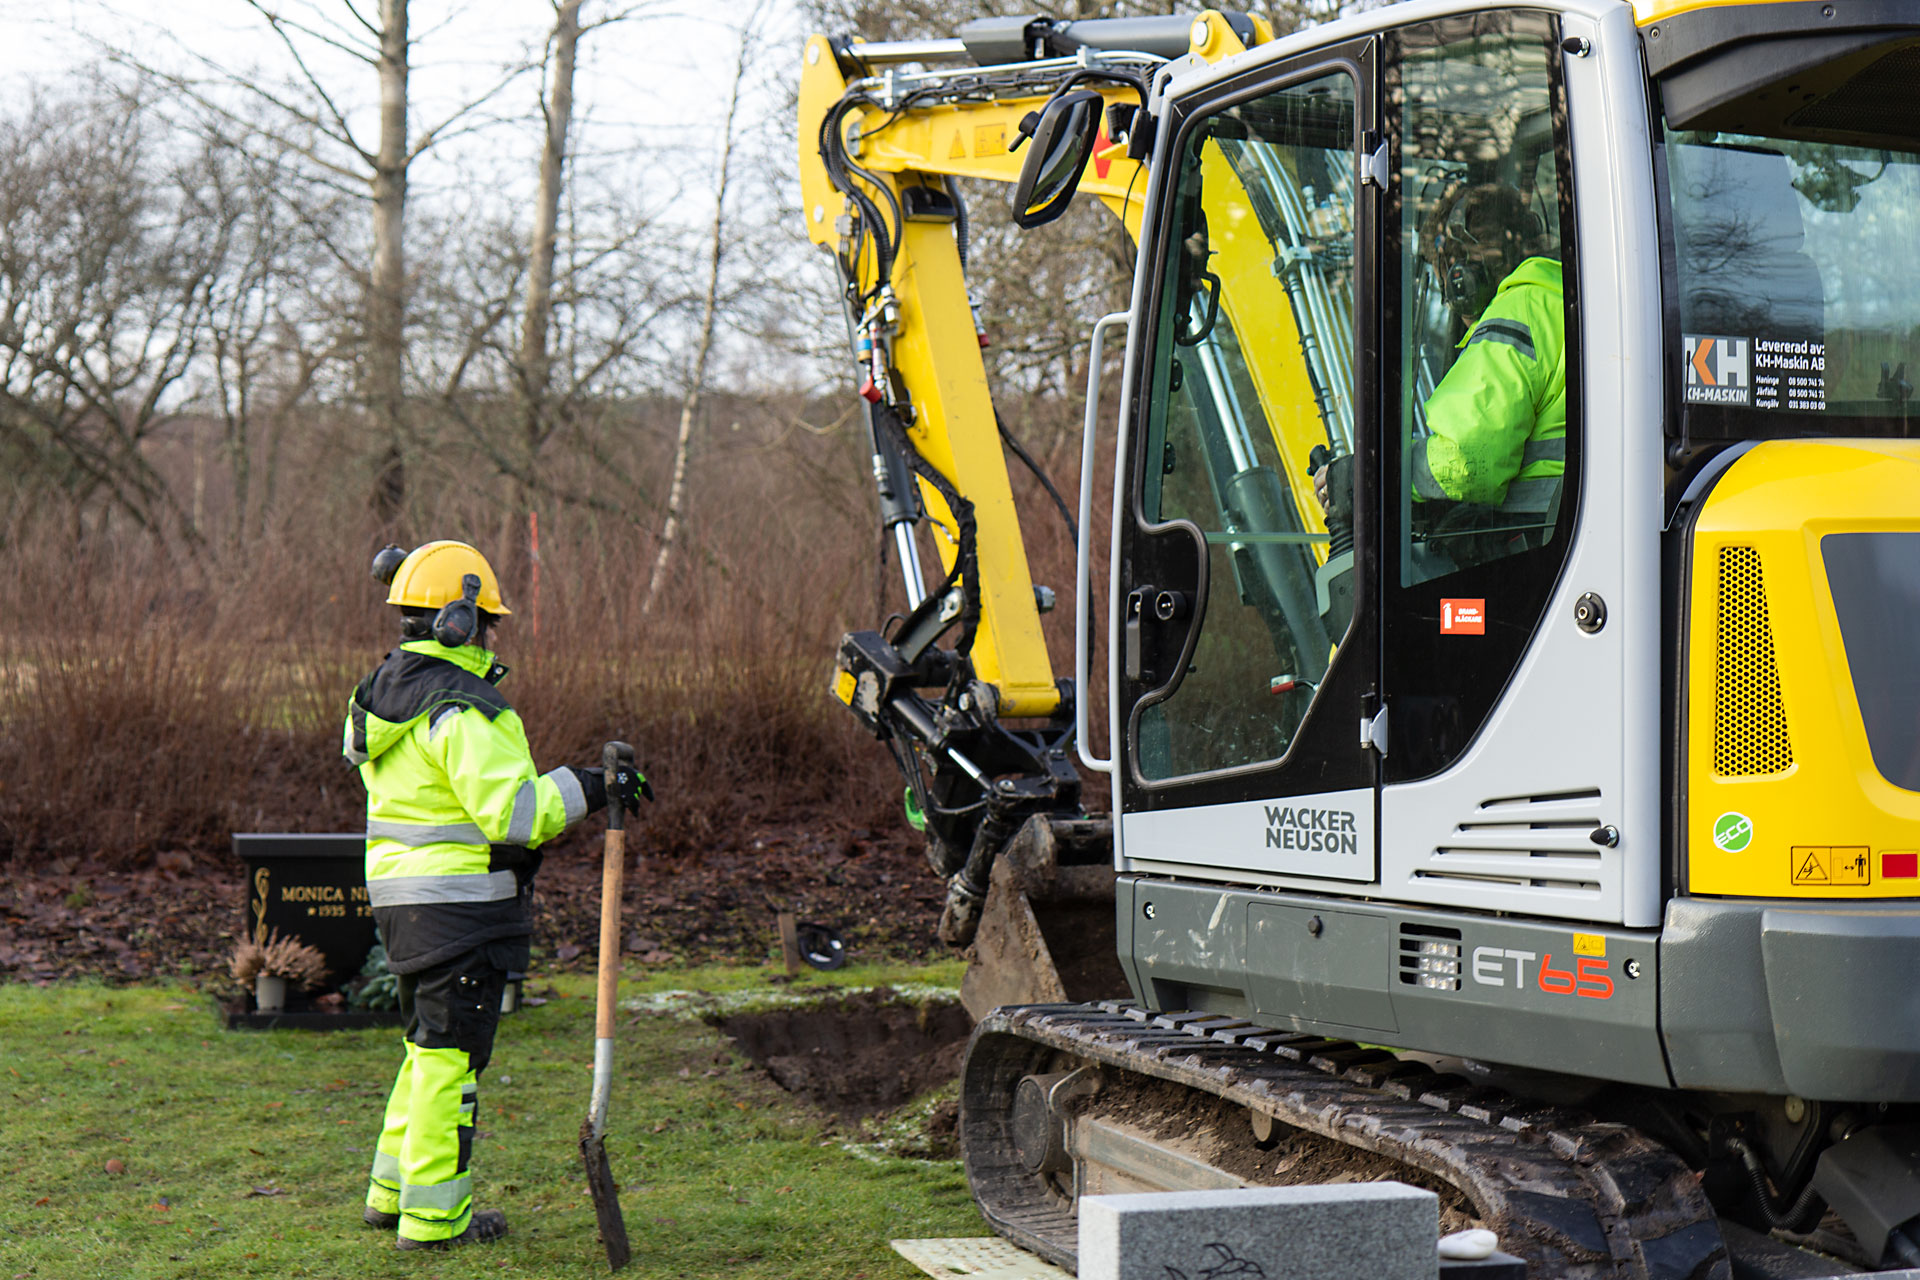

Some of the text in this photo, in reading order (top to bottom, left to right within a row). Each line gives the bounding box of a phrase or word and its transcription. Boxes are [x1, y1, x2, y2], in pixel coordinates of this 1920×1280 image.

[1755, 337, 1825, 355] Levererad av:
[1684, 337, 1748, 387] KH
[1755, 353, 1825, 371] KH-Maskin AB
[1755, 374, 1780, 386] Haninge
[1755, 398, 1780, 410] Kungälv
[1264, 805, 1357, 833] WACKER
[1266, 827, 1357, 855] NEUSON
[1715, 817, 1752, 847] ECO
[281, 886, 345, 902] MONICA
